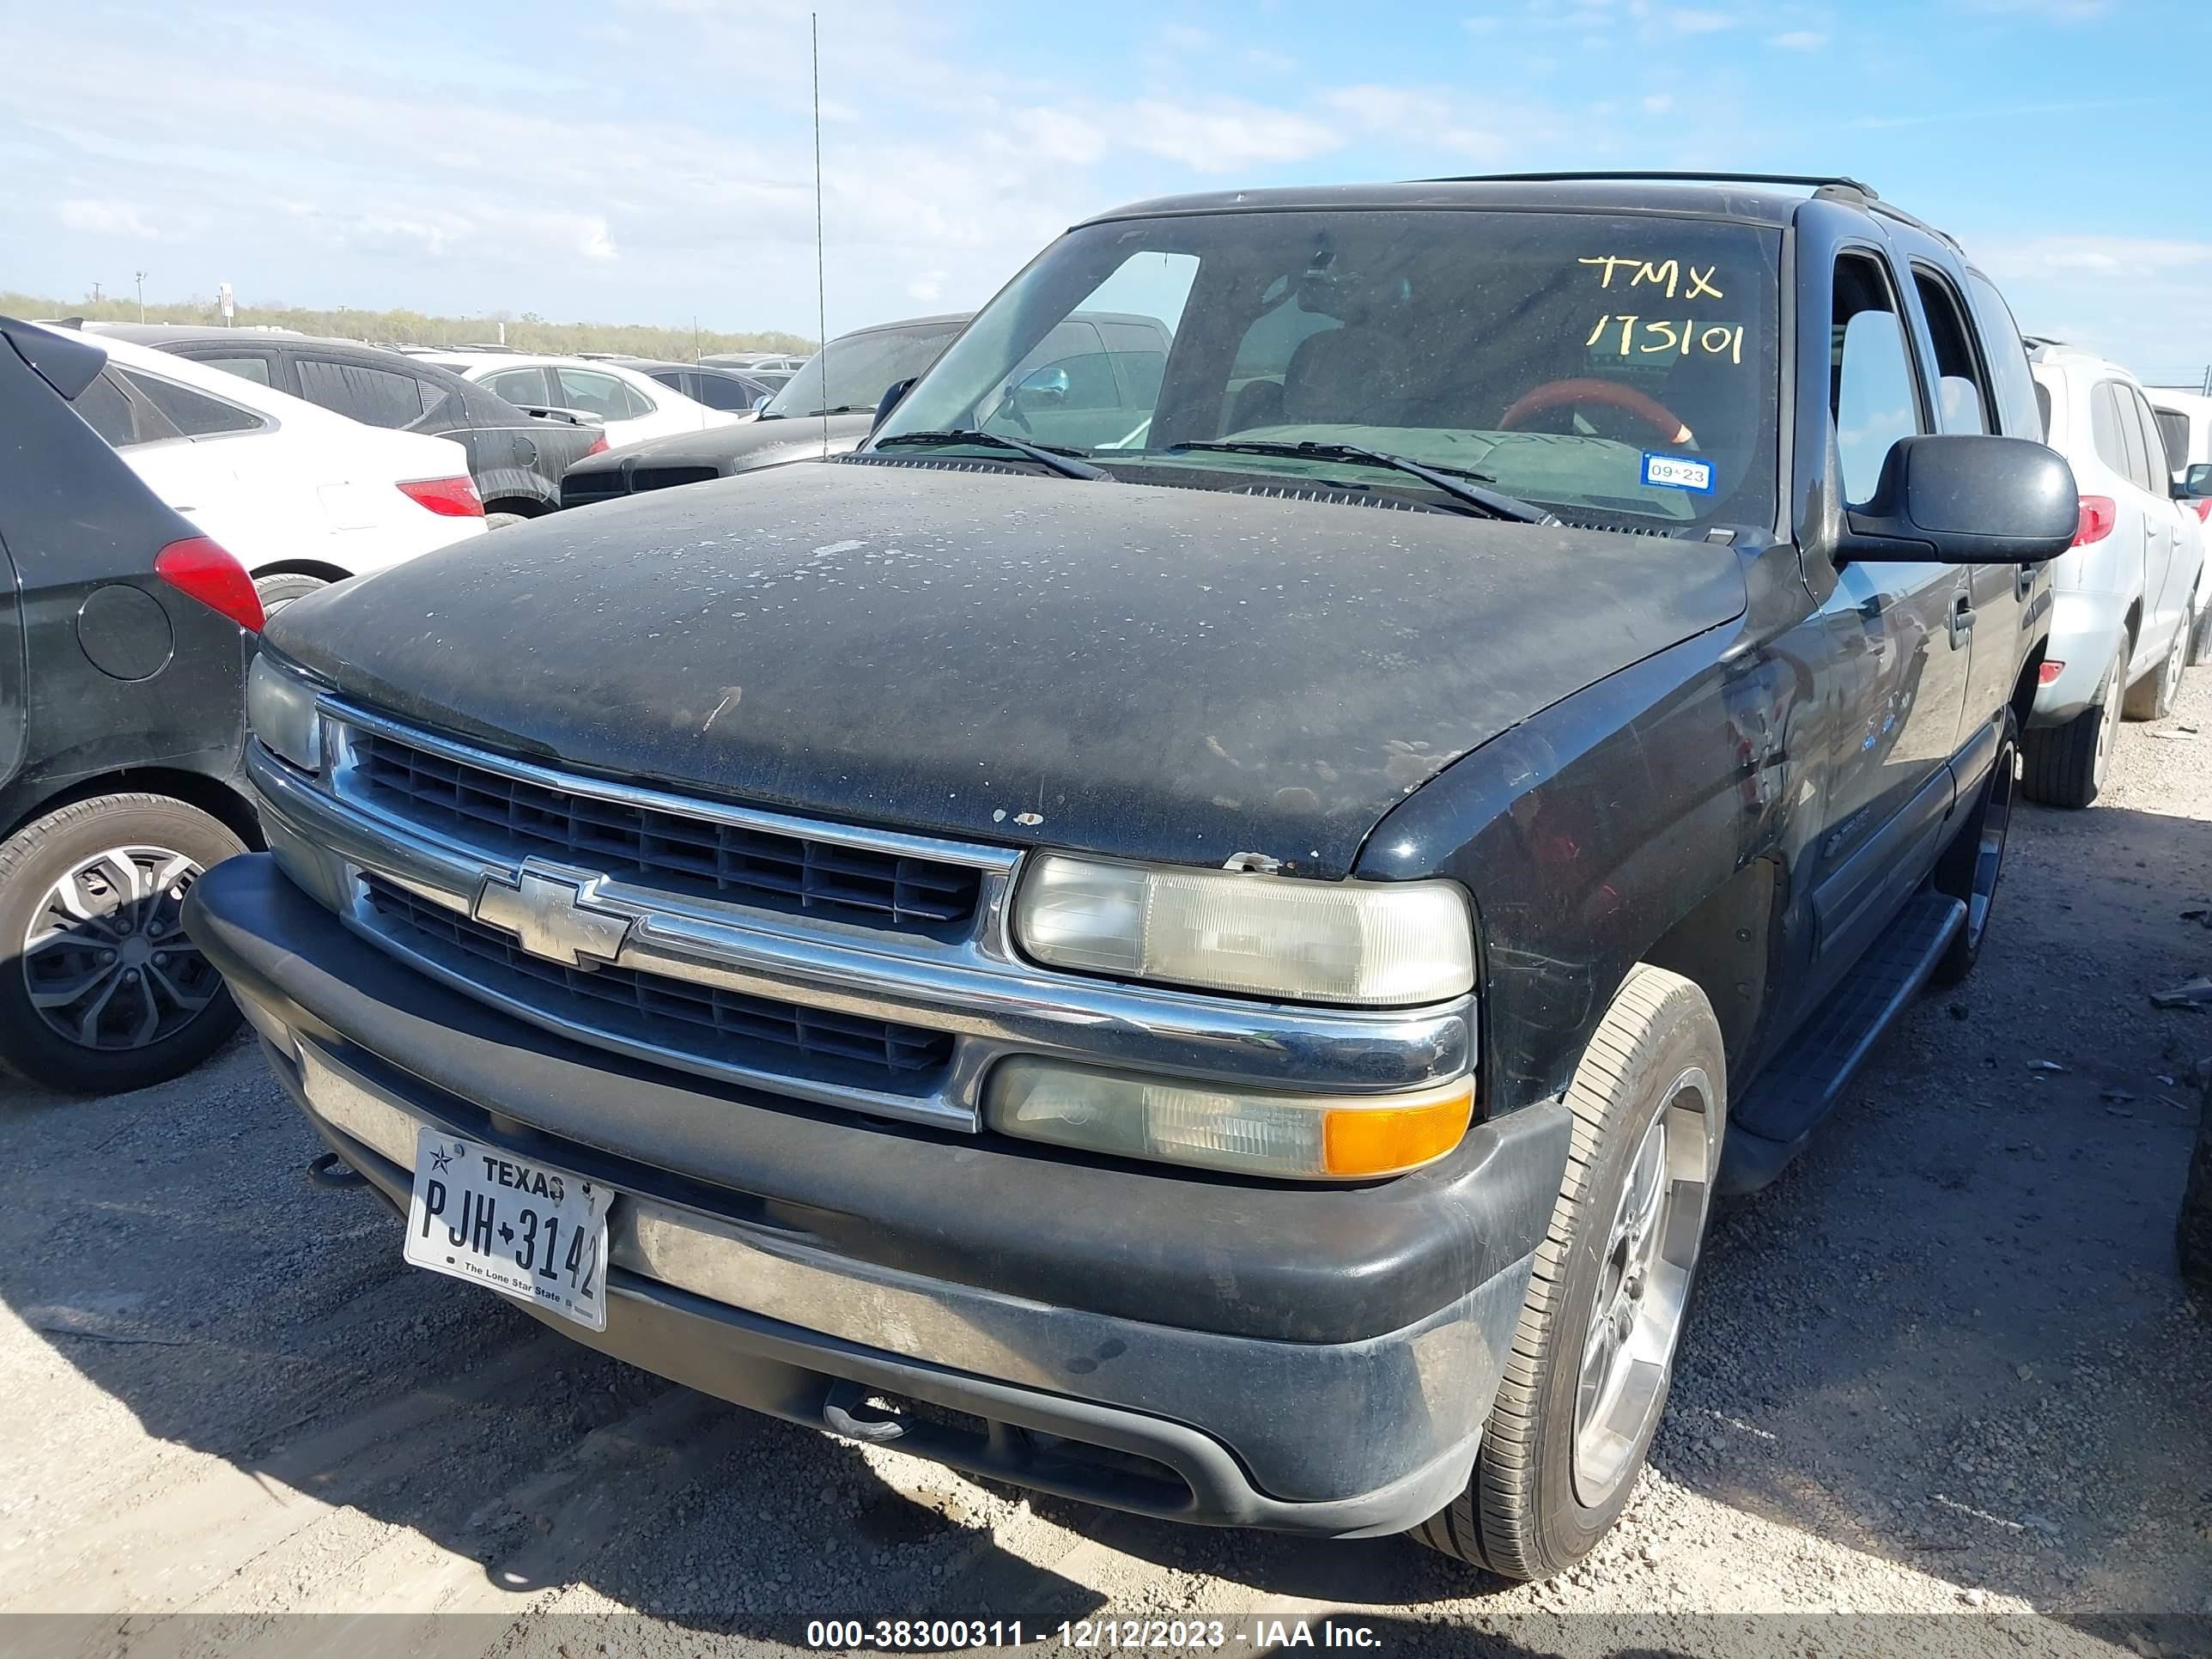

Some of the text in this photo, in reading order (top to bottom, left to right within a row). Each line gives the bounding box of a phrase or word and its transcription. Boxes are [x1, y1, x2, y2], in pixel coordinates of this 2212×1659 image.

[1577, 255, 1723, 299] TMX
[1585, 314, 1744, 364] 175101
[483, 1156, 565, 1202] TEXAS
[465, 1261, 561, 1302] The Lone Star State
